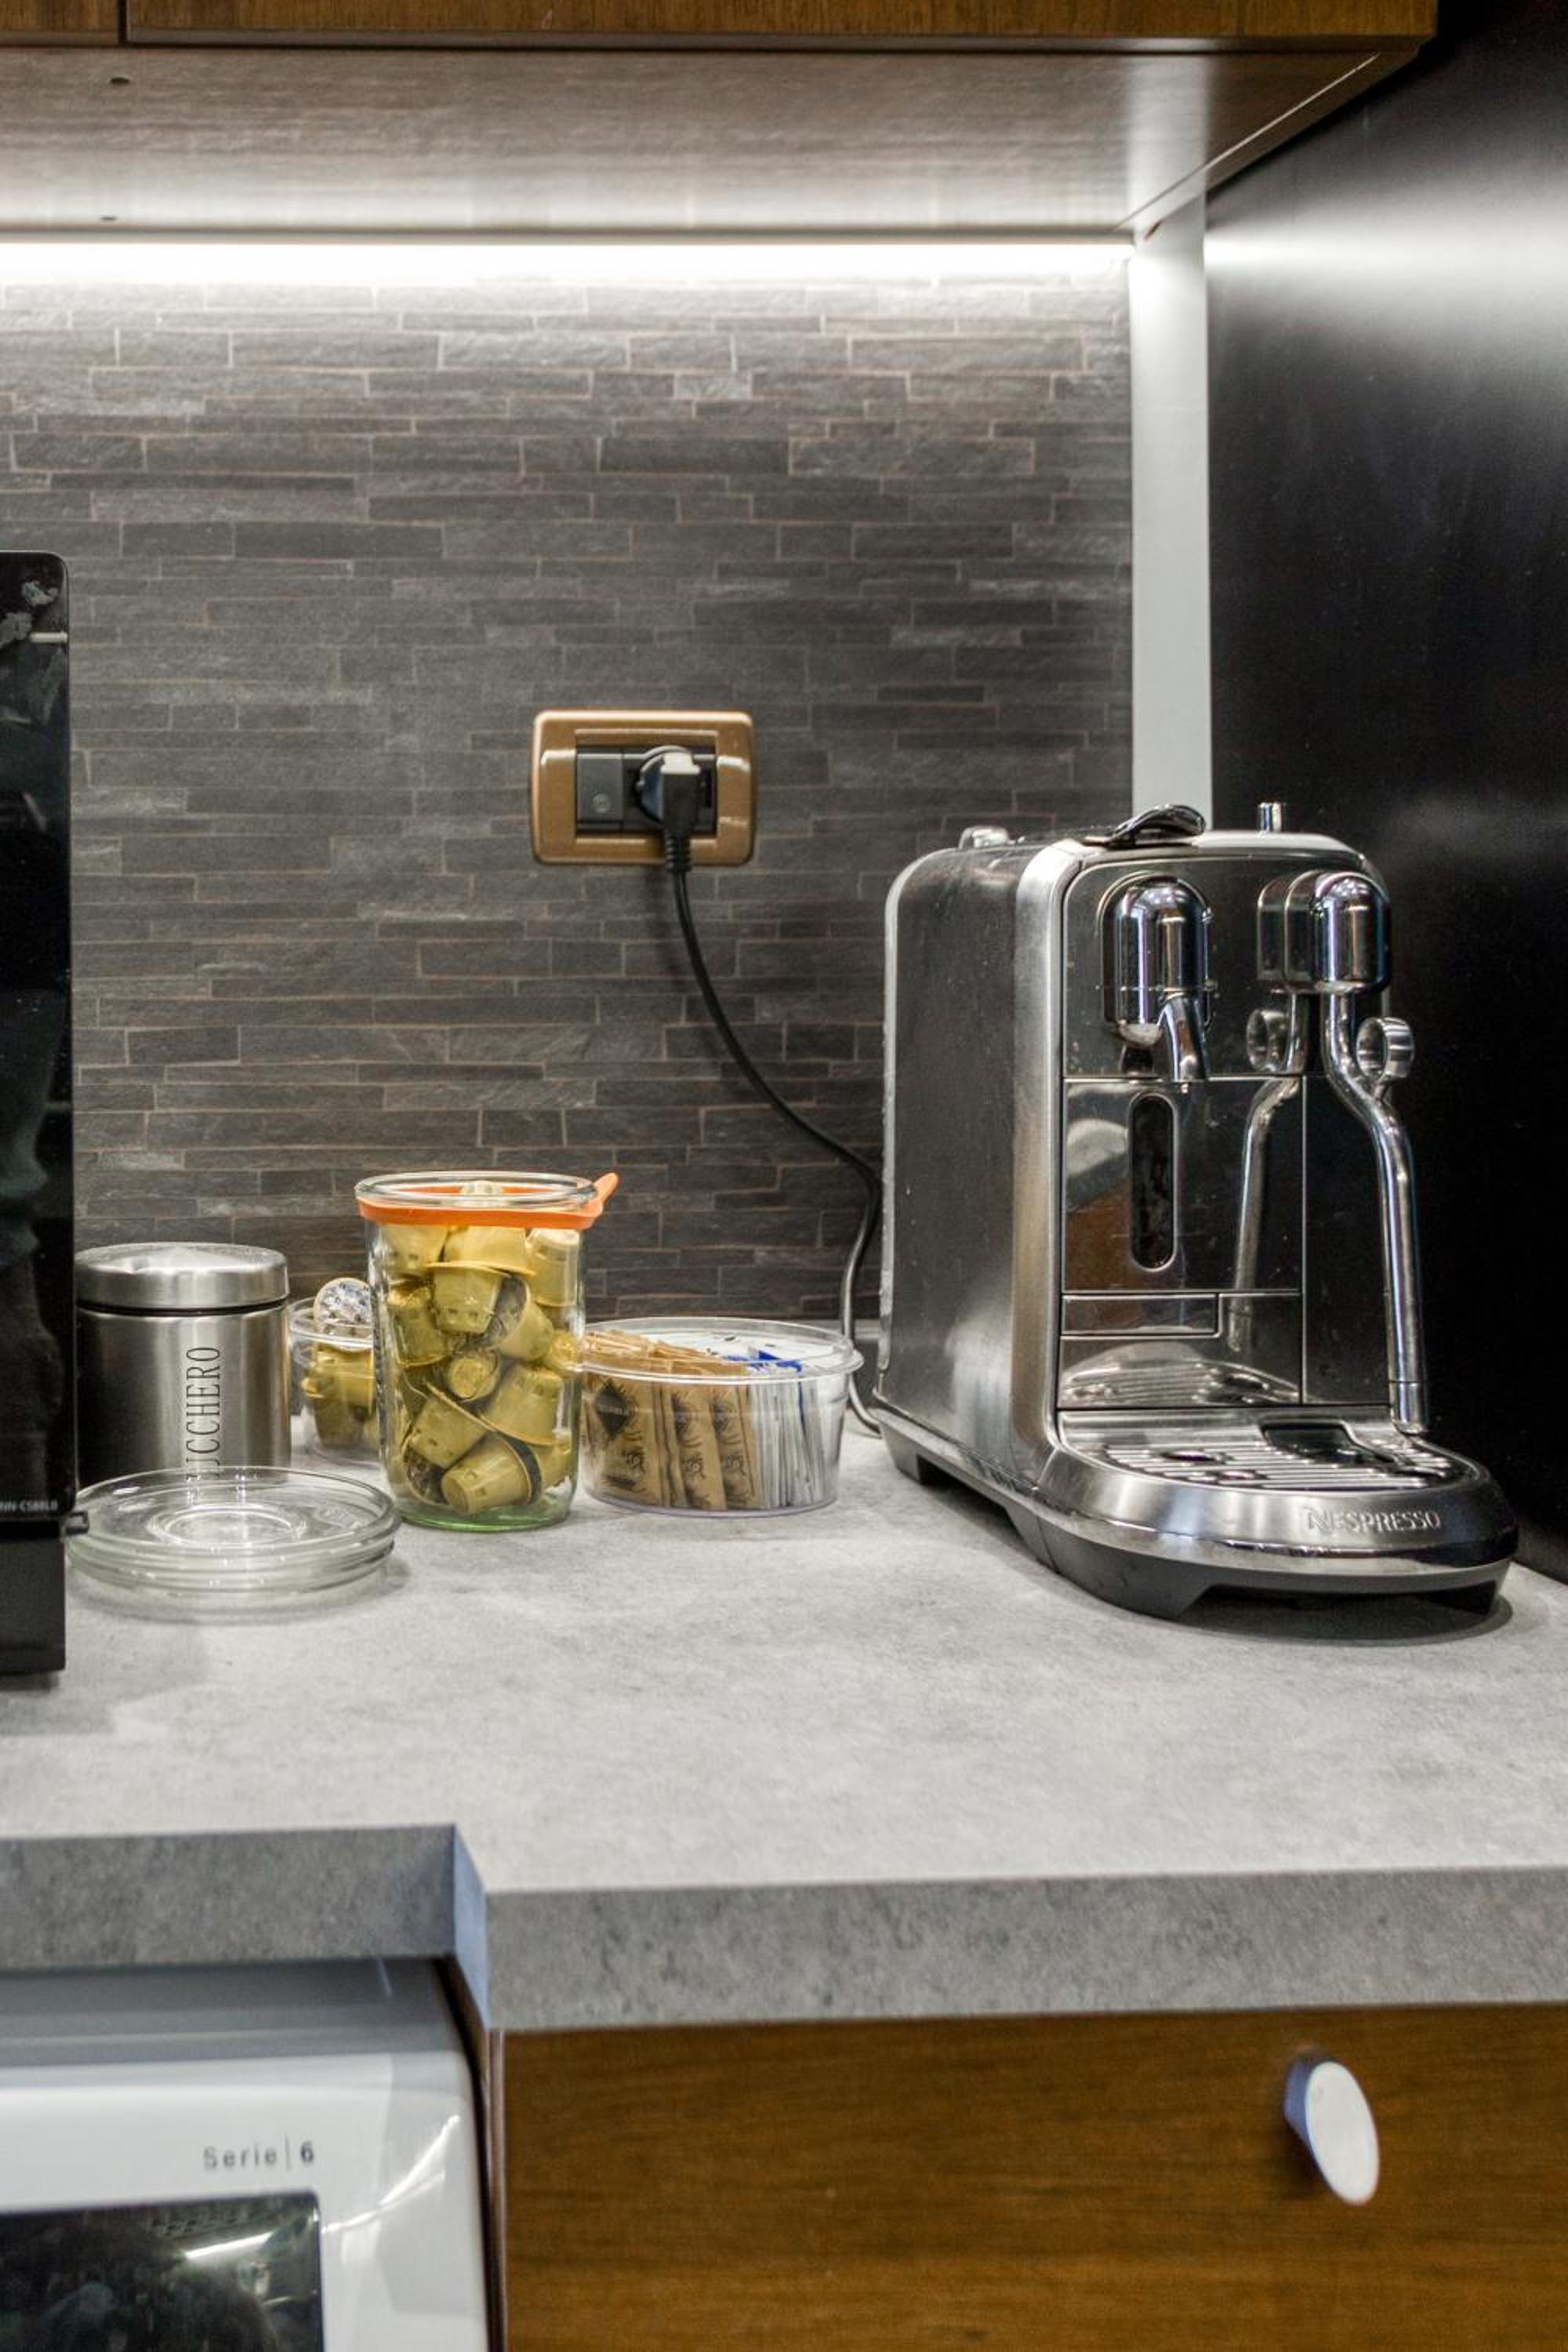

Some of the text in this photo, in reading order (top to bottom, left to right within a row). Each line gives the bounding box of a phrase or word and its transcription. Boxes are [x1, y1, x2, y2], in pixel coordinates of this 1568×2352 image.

[1305, 1504, 1442, 1532] NESPRESSO
[203, 2140, 314, 2171] Serie 6
